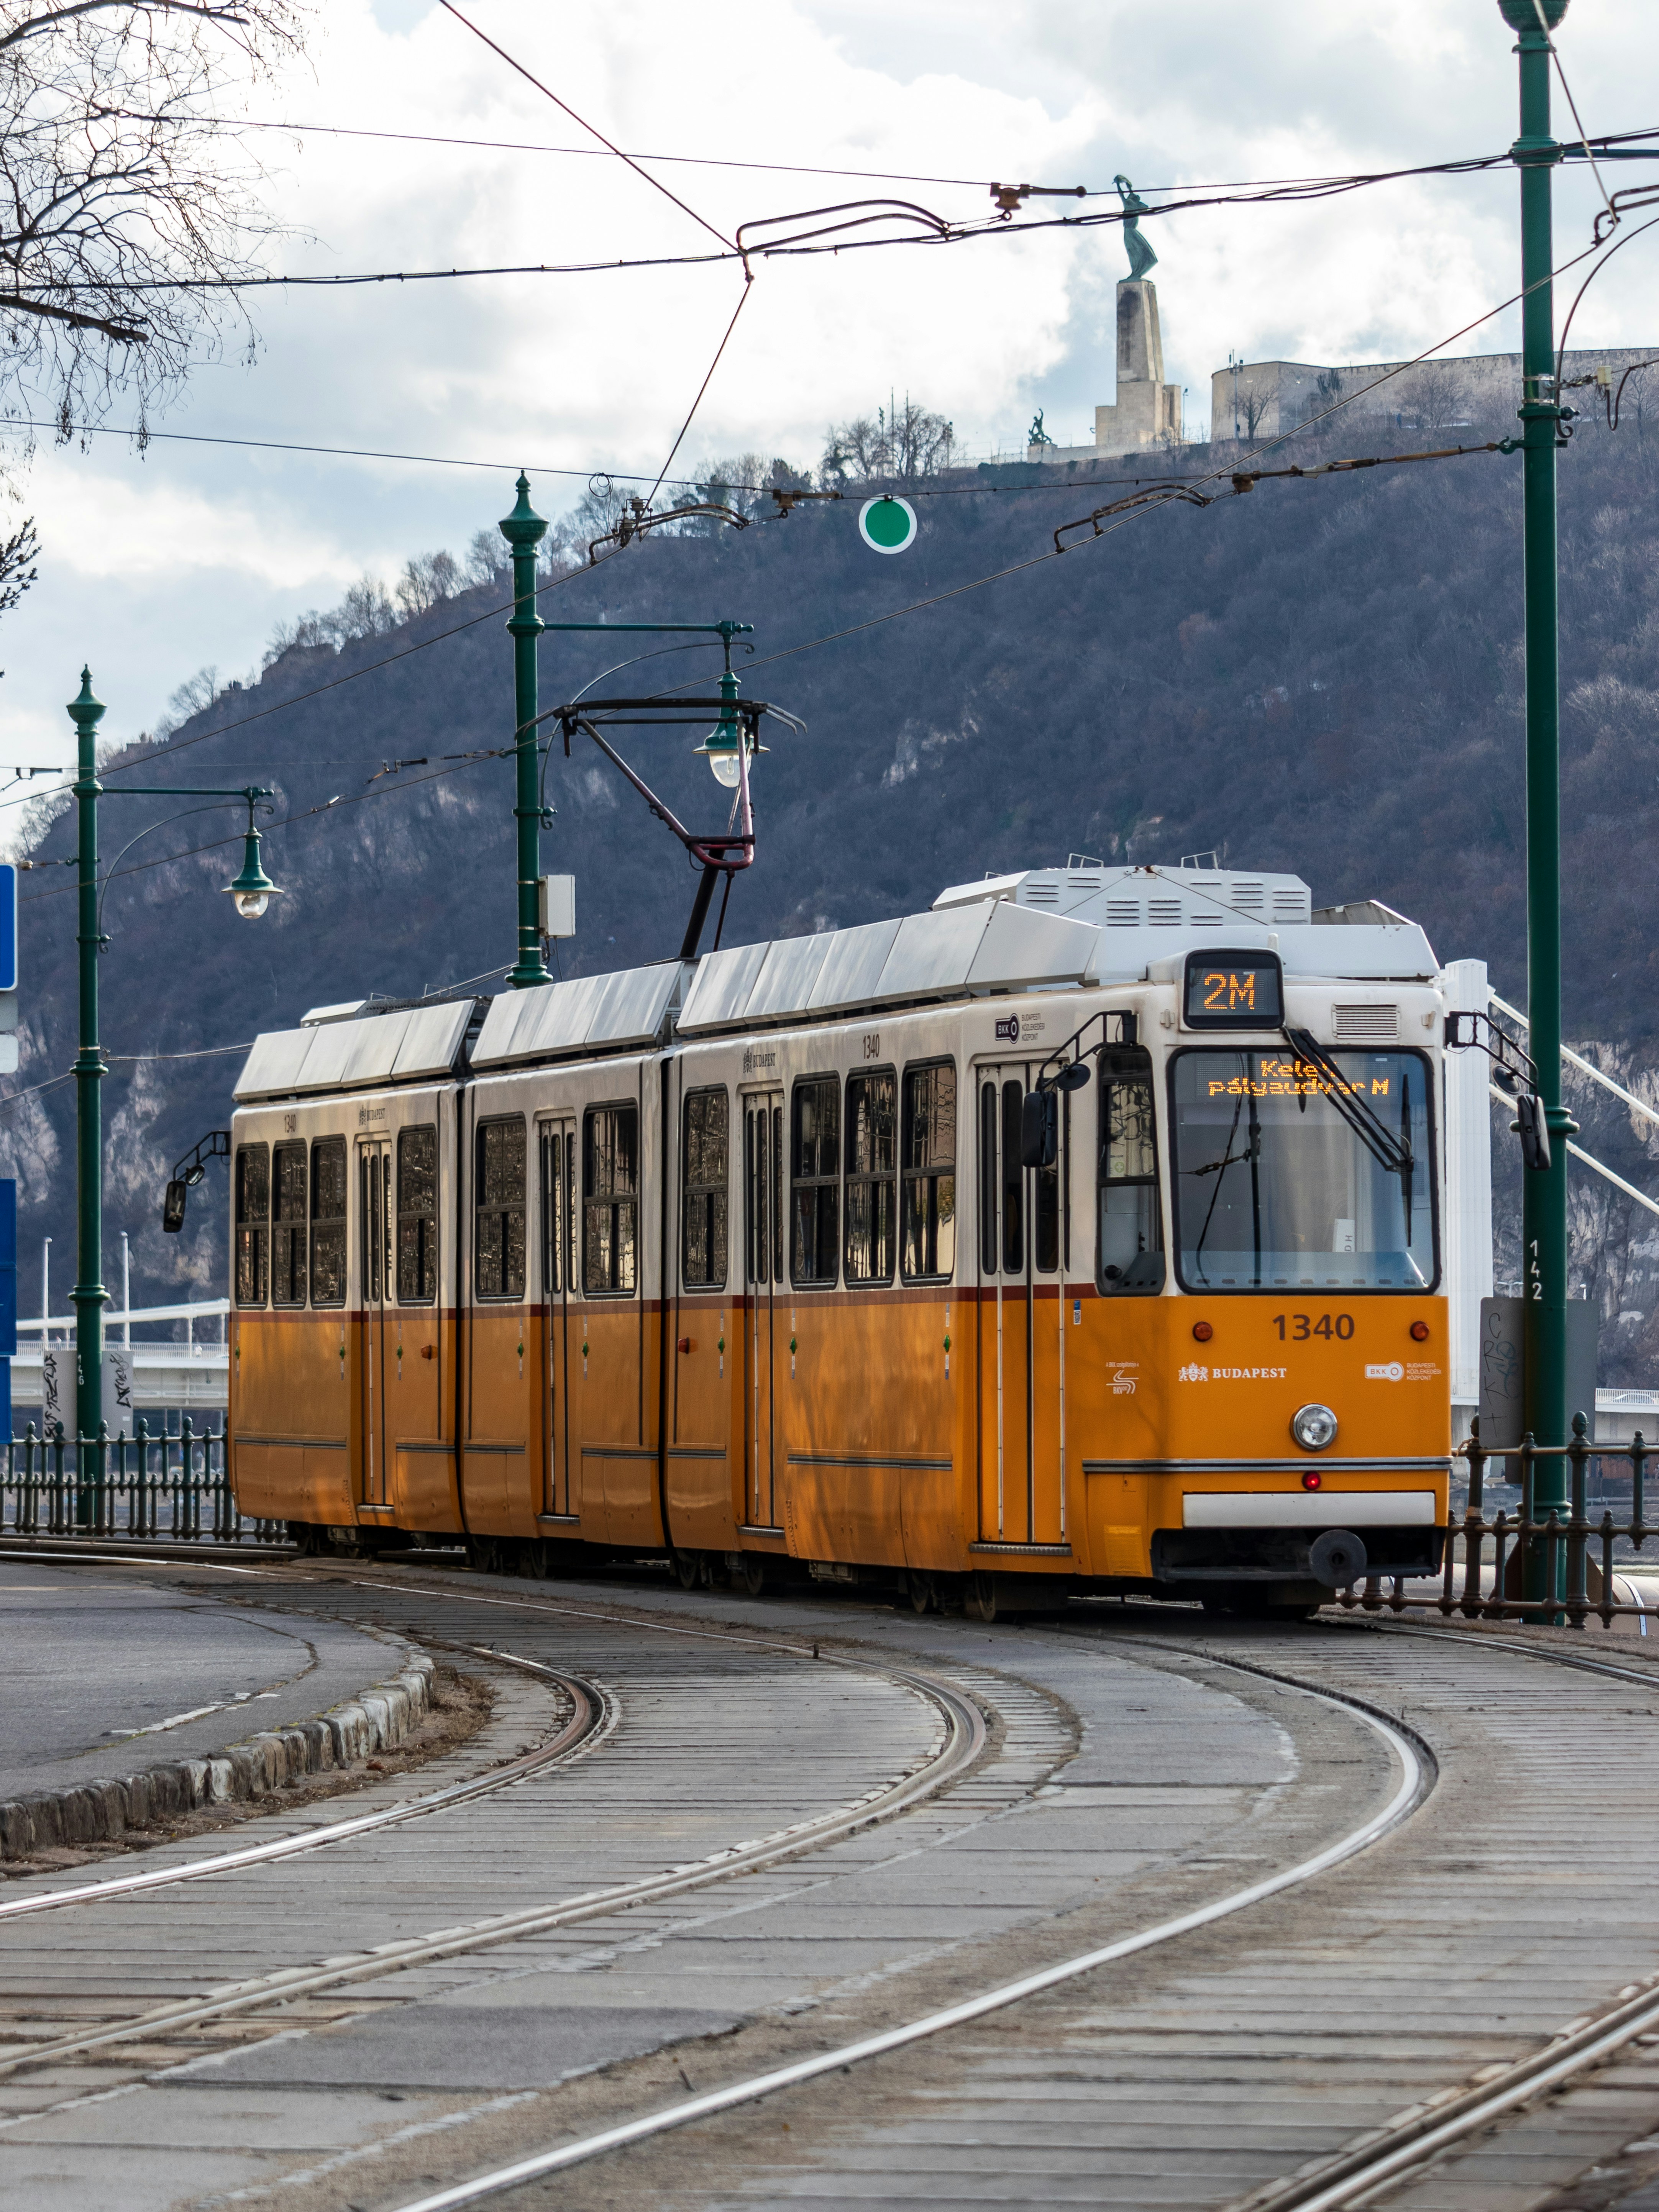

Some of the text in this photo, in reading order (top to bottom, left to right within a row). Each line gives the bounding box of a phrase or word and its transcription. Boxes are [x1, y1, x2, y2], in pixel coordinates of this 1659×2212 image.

[1204, 974, 1255, 1010] 2M
[998, 1025, 1009, 1034] BKK
[863, 1033, 880, 1059] 1340
[753, 1053, 776, 1068] BUDAPEST
[1261, 1061, 1337, 1077] Kele
[1371, 1079, 1388, 1095] M
[284, 1114, 296, 1133] 1340
[1530, 1240, 1542, 1300] 142
[1273, 1313, 1355, 1341] 1340
[1213, 1368, 1287, 1378] BUDAPEST
